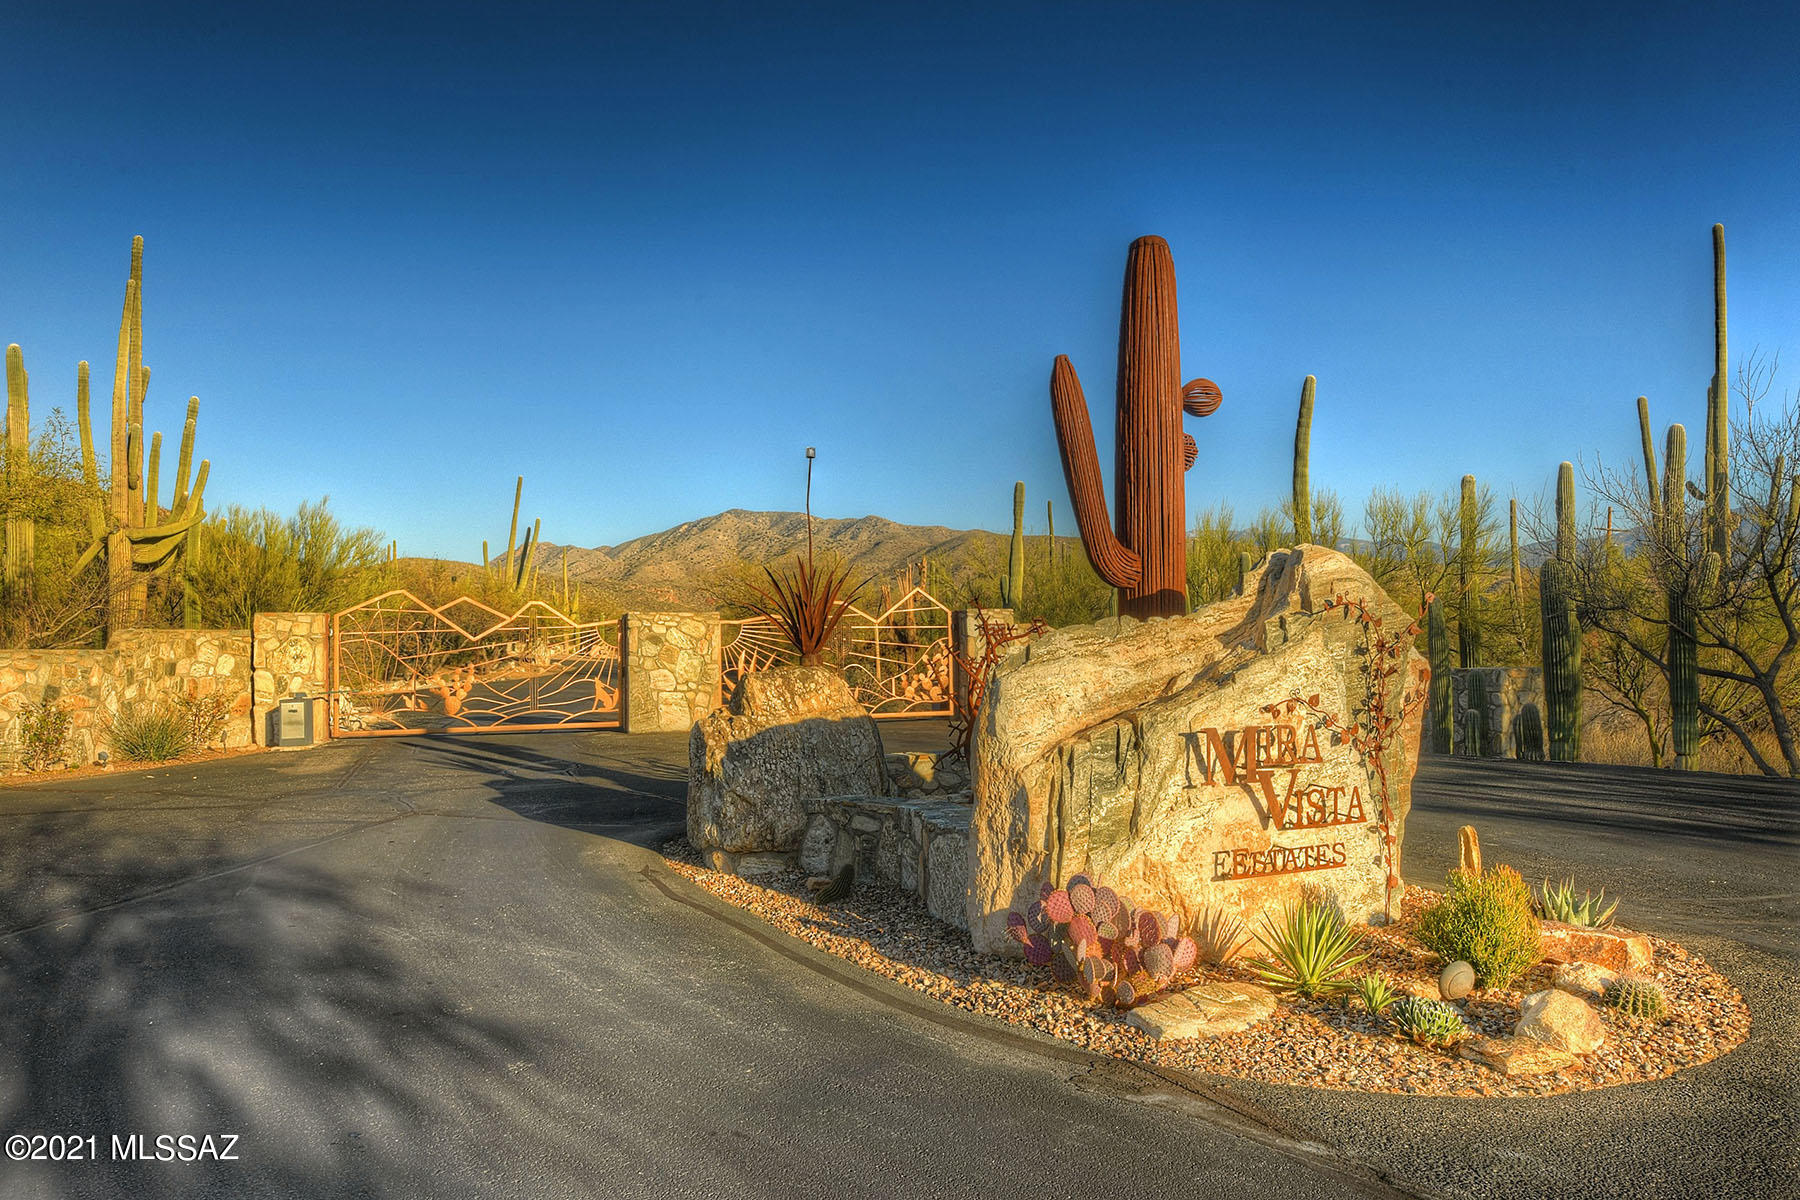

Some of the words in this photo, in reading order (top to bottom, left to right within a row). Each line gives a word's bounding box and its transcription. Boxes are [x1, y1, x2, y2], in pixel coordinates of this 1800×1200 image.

[1200, 723, 1323, 787] MIRA
[1256, 768, 1367, 831] VISTA
[1231, 842, 1347, 880] ESTATES
